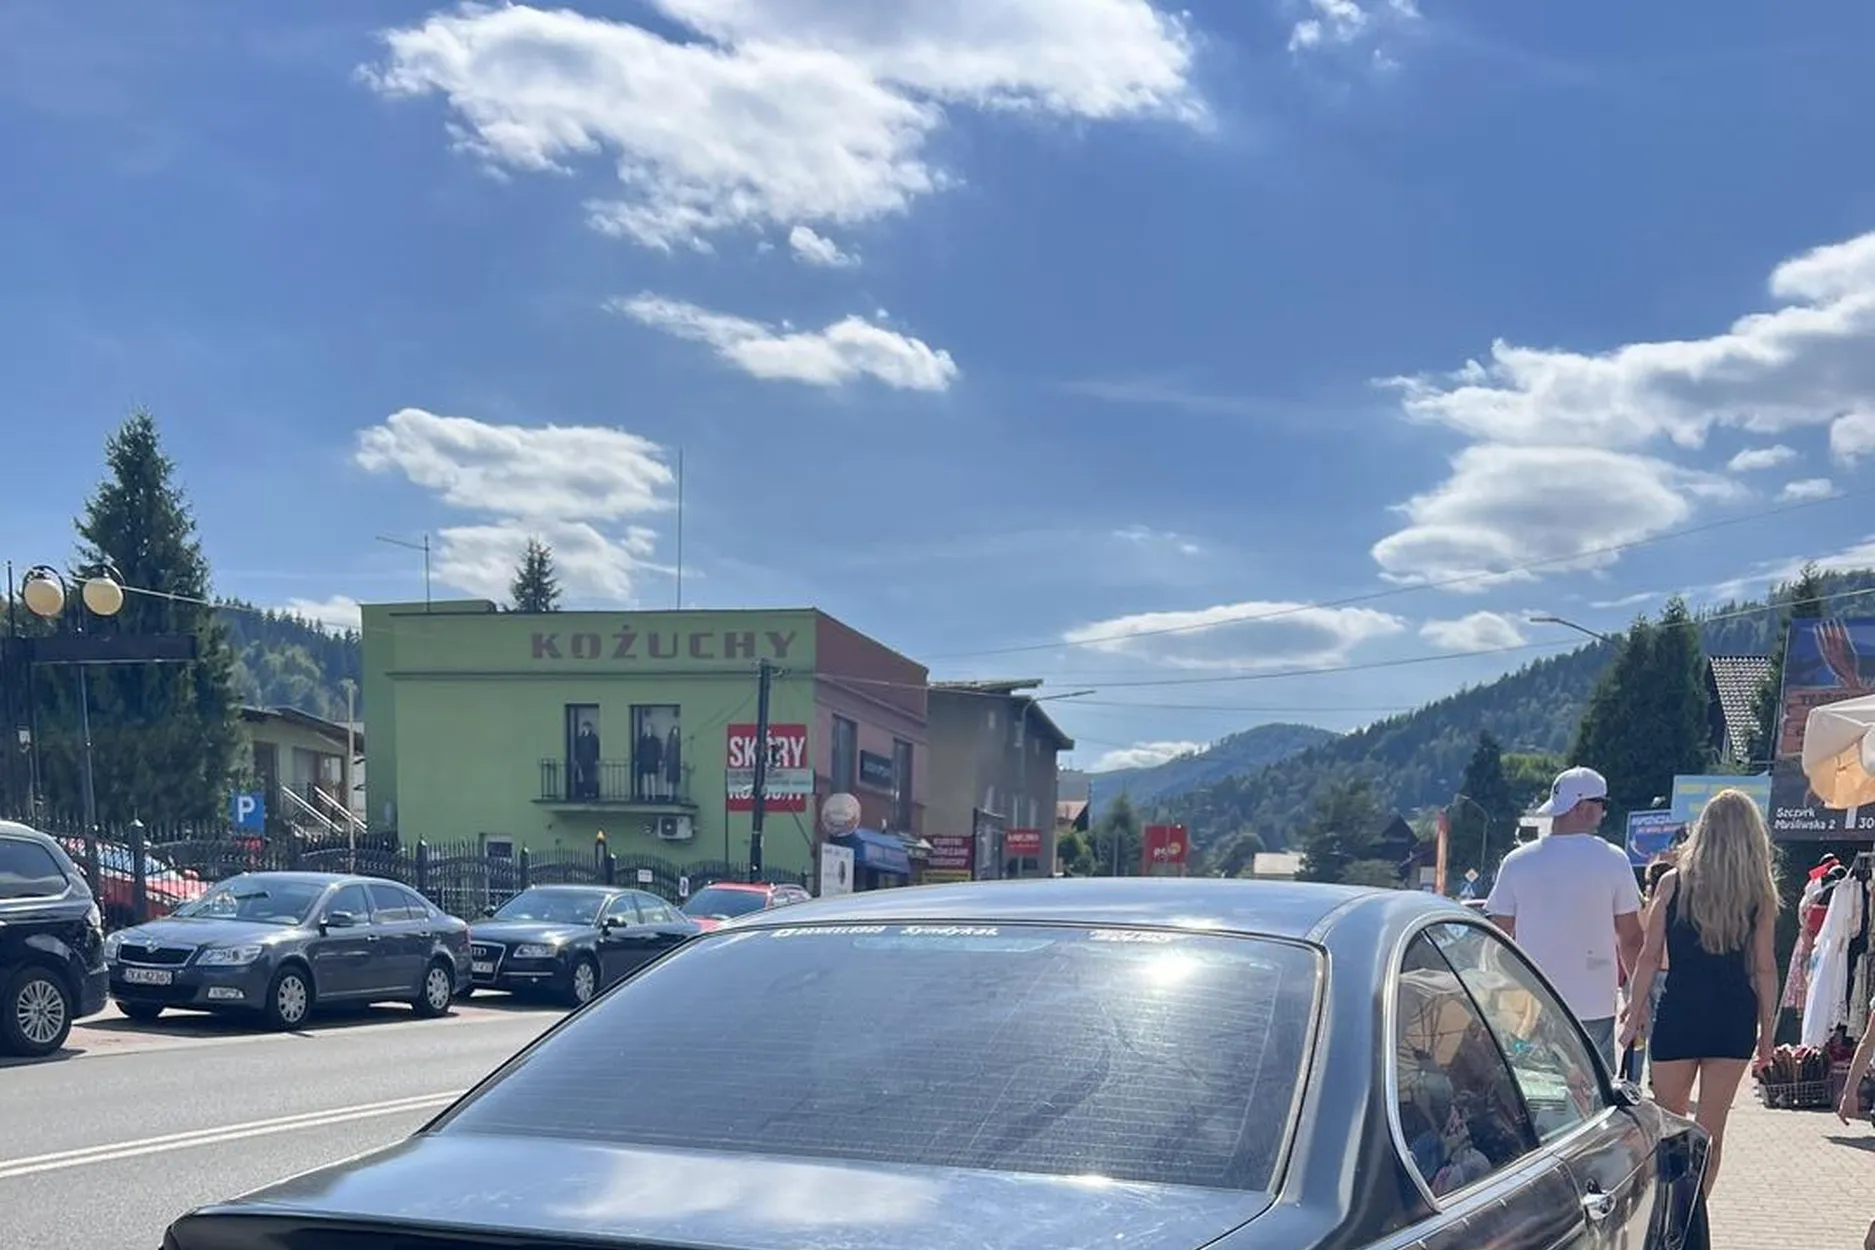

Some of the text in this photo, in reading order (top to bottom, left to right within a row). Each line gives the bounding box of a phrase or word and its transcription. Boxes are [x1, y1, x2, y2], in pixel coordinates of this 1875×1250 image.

[531, 624, 797, 659] KOŻUCHY
[237, 795, 256, 823] P
[1828, 819, 1836, 830] 2
